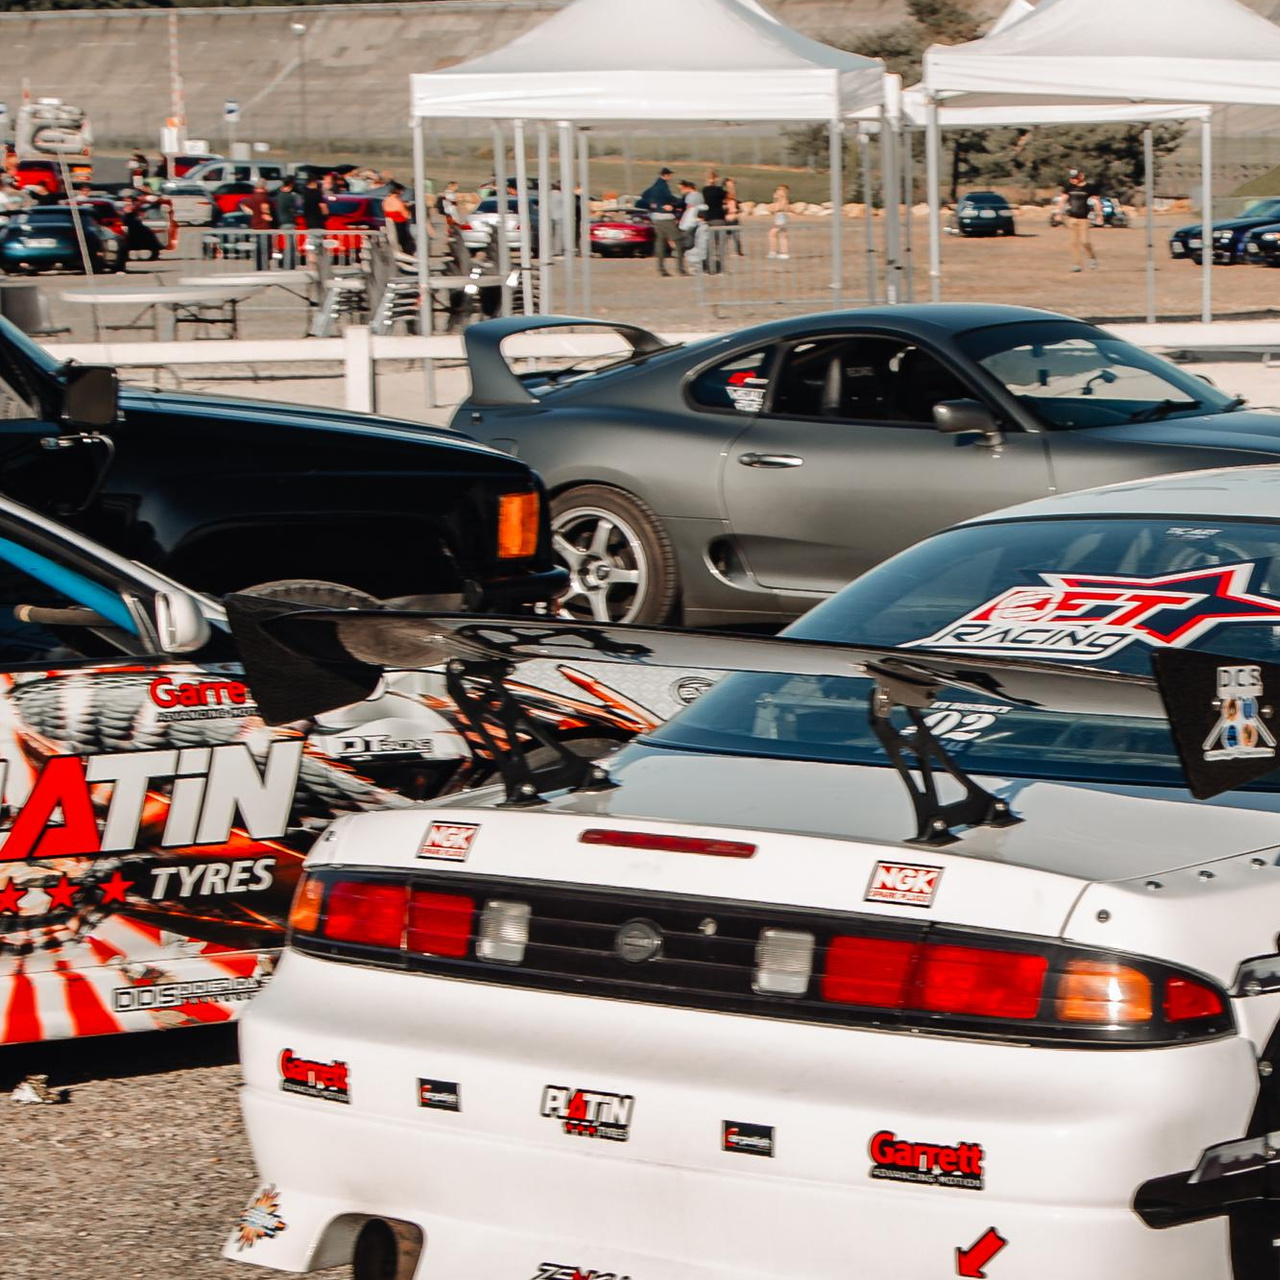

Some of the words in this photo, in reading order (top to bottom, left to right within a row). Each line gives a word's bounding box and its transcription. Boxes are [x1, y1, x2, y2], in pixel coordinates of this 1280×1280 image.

[950, 622, 1133, 653] RACING
[151, 858, 277, 900] TYRES
[870, 865, 940, 895] NGK
[870, 1130, 983, 1175] Garrett
